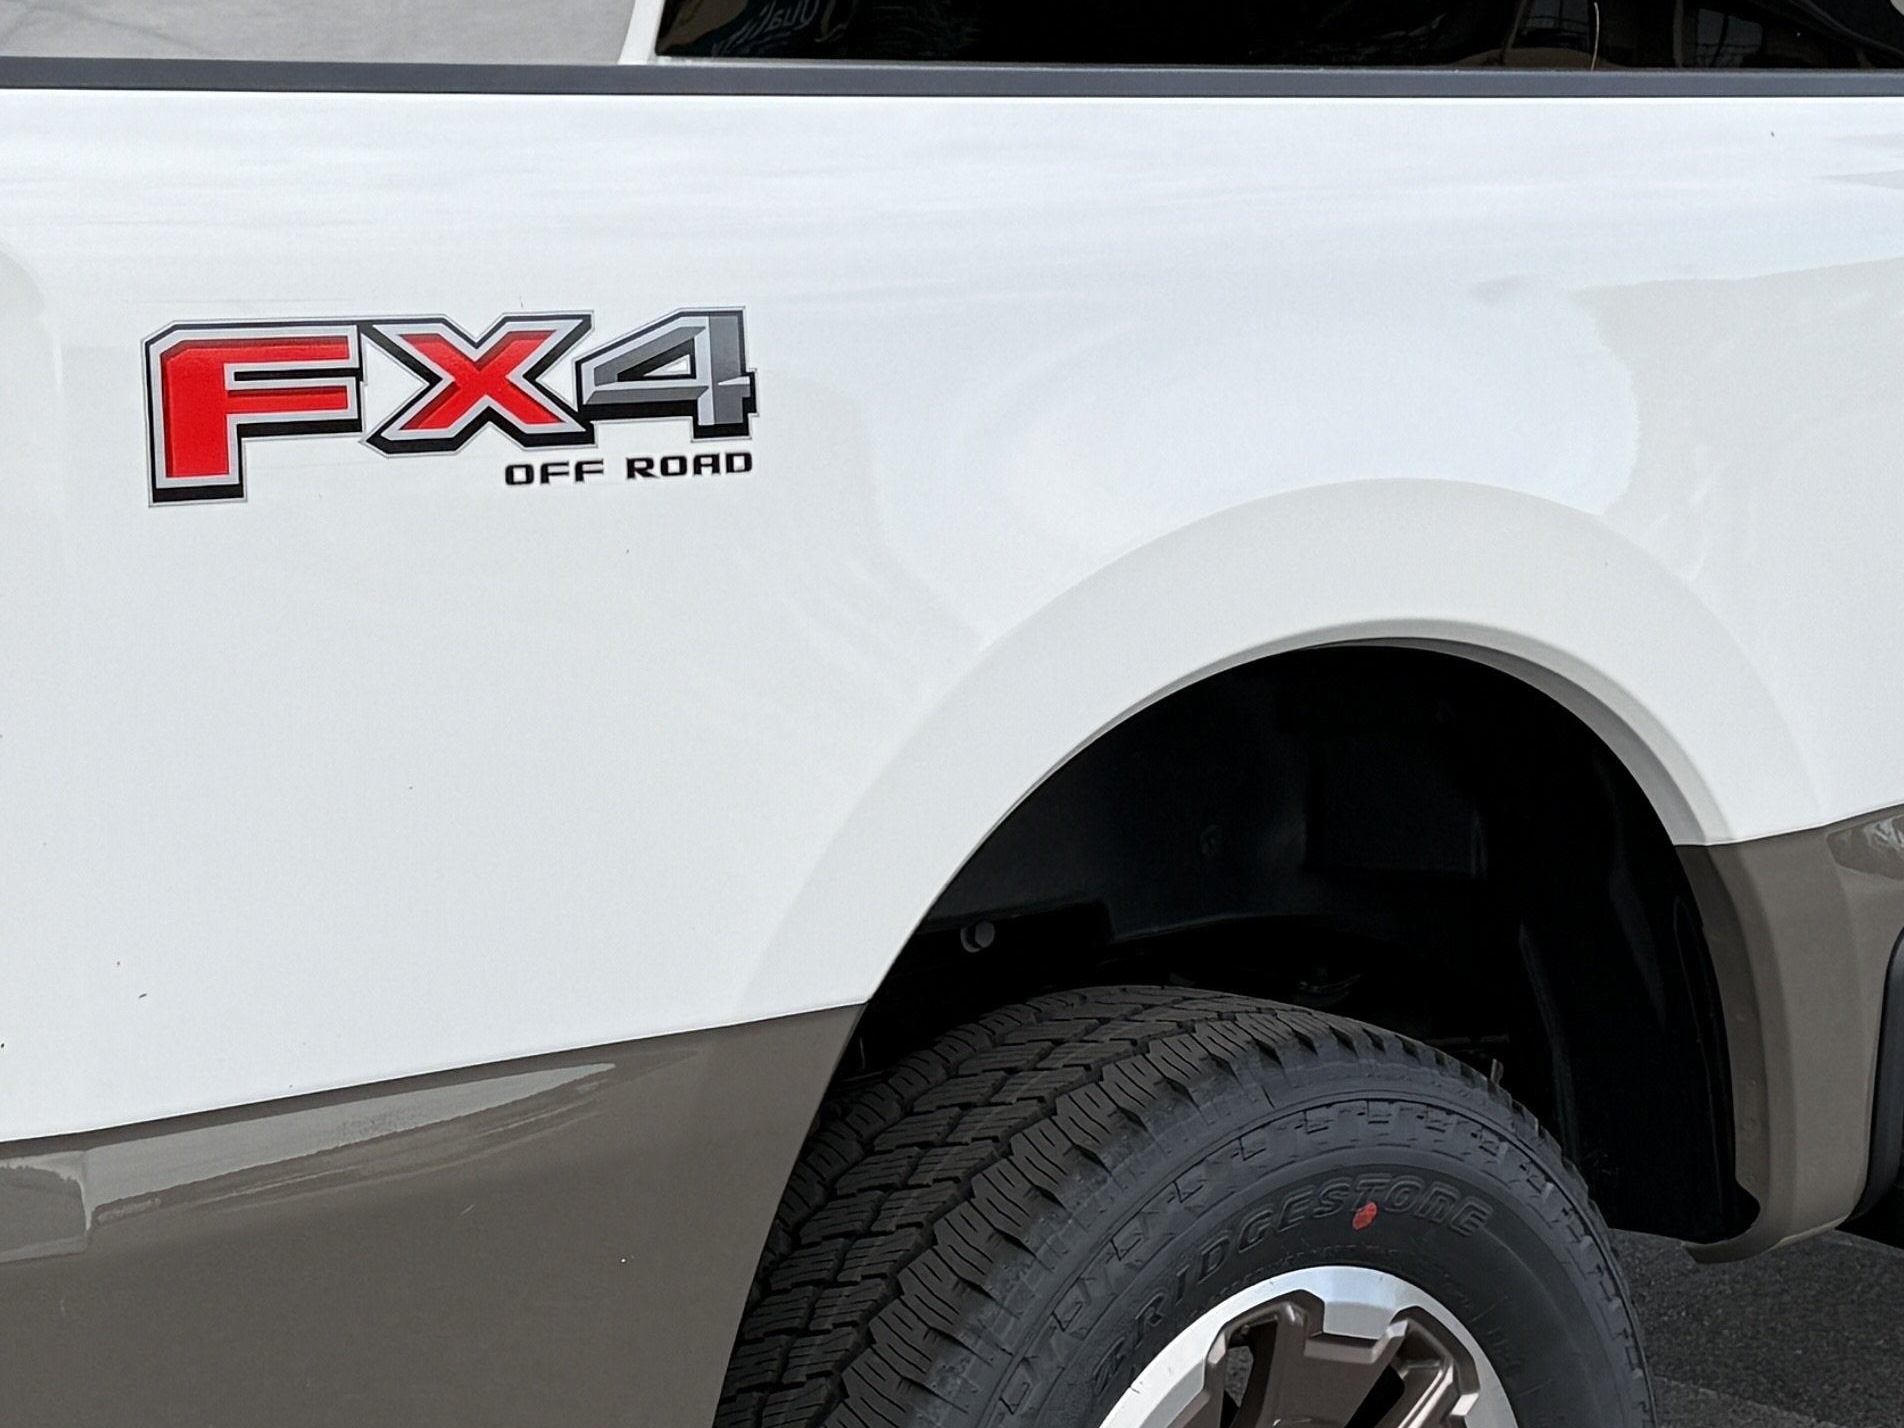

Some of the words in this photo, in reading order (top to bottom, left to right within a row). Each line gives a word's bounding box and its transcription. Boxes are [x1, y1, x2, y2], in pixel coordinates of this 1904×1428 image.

[142, 307, 759, 507] FX4
[504, 457, 605, 486] OFF
[626, 451, 753, 481] ROAD
[1097, 1174, 1494, 1396] BRIDGESTONE
